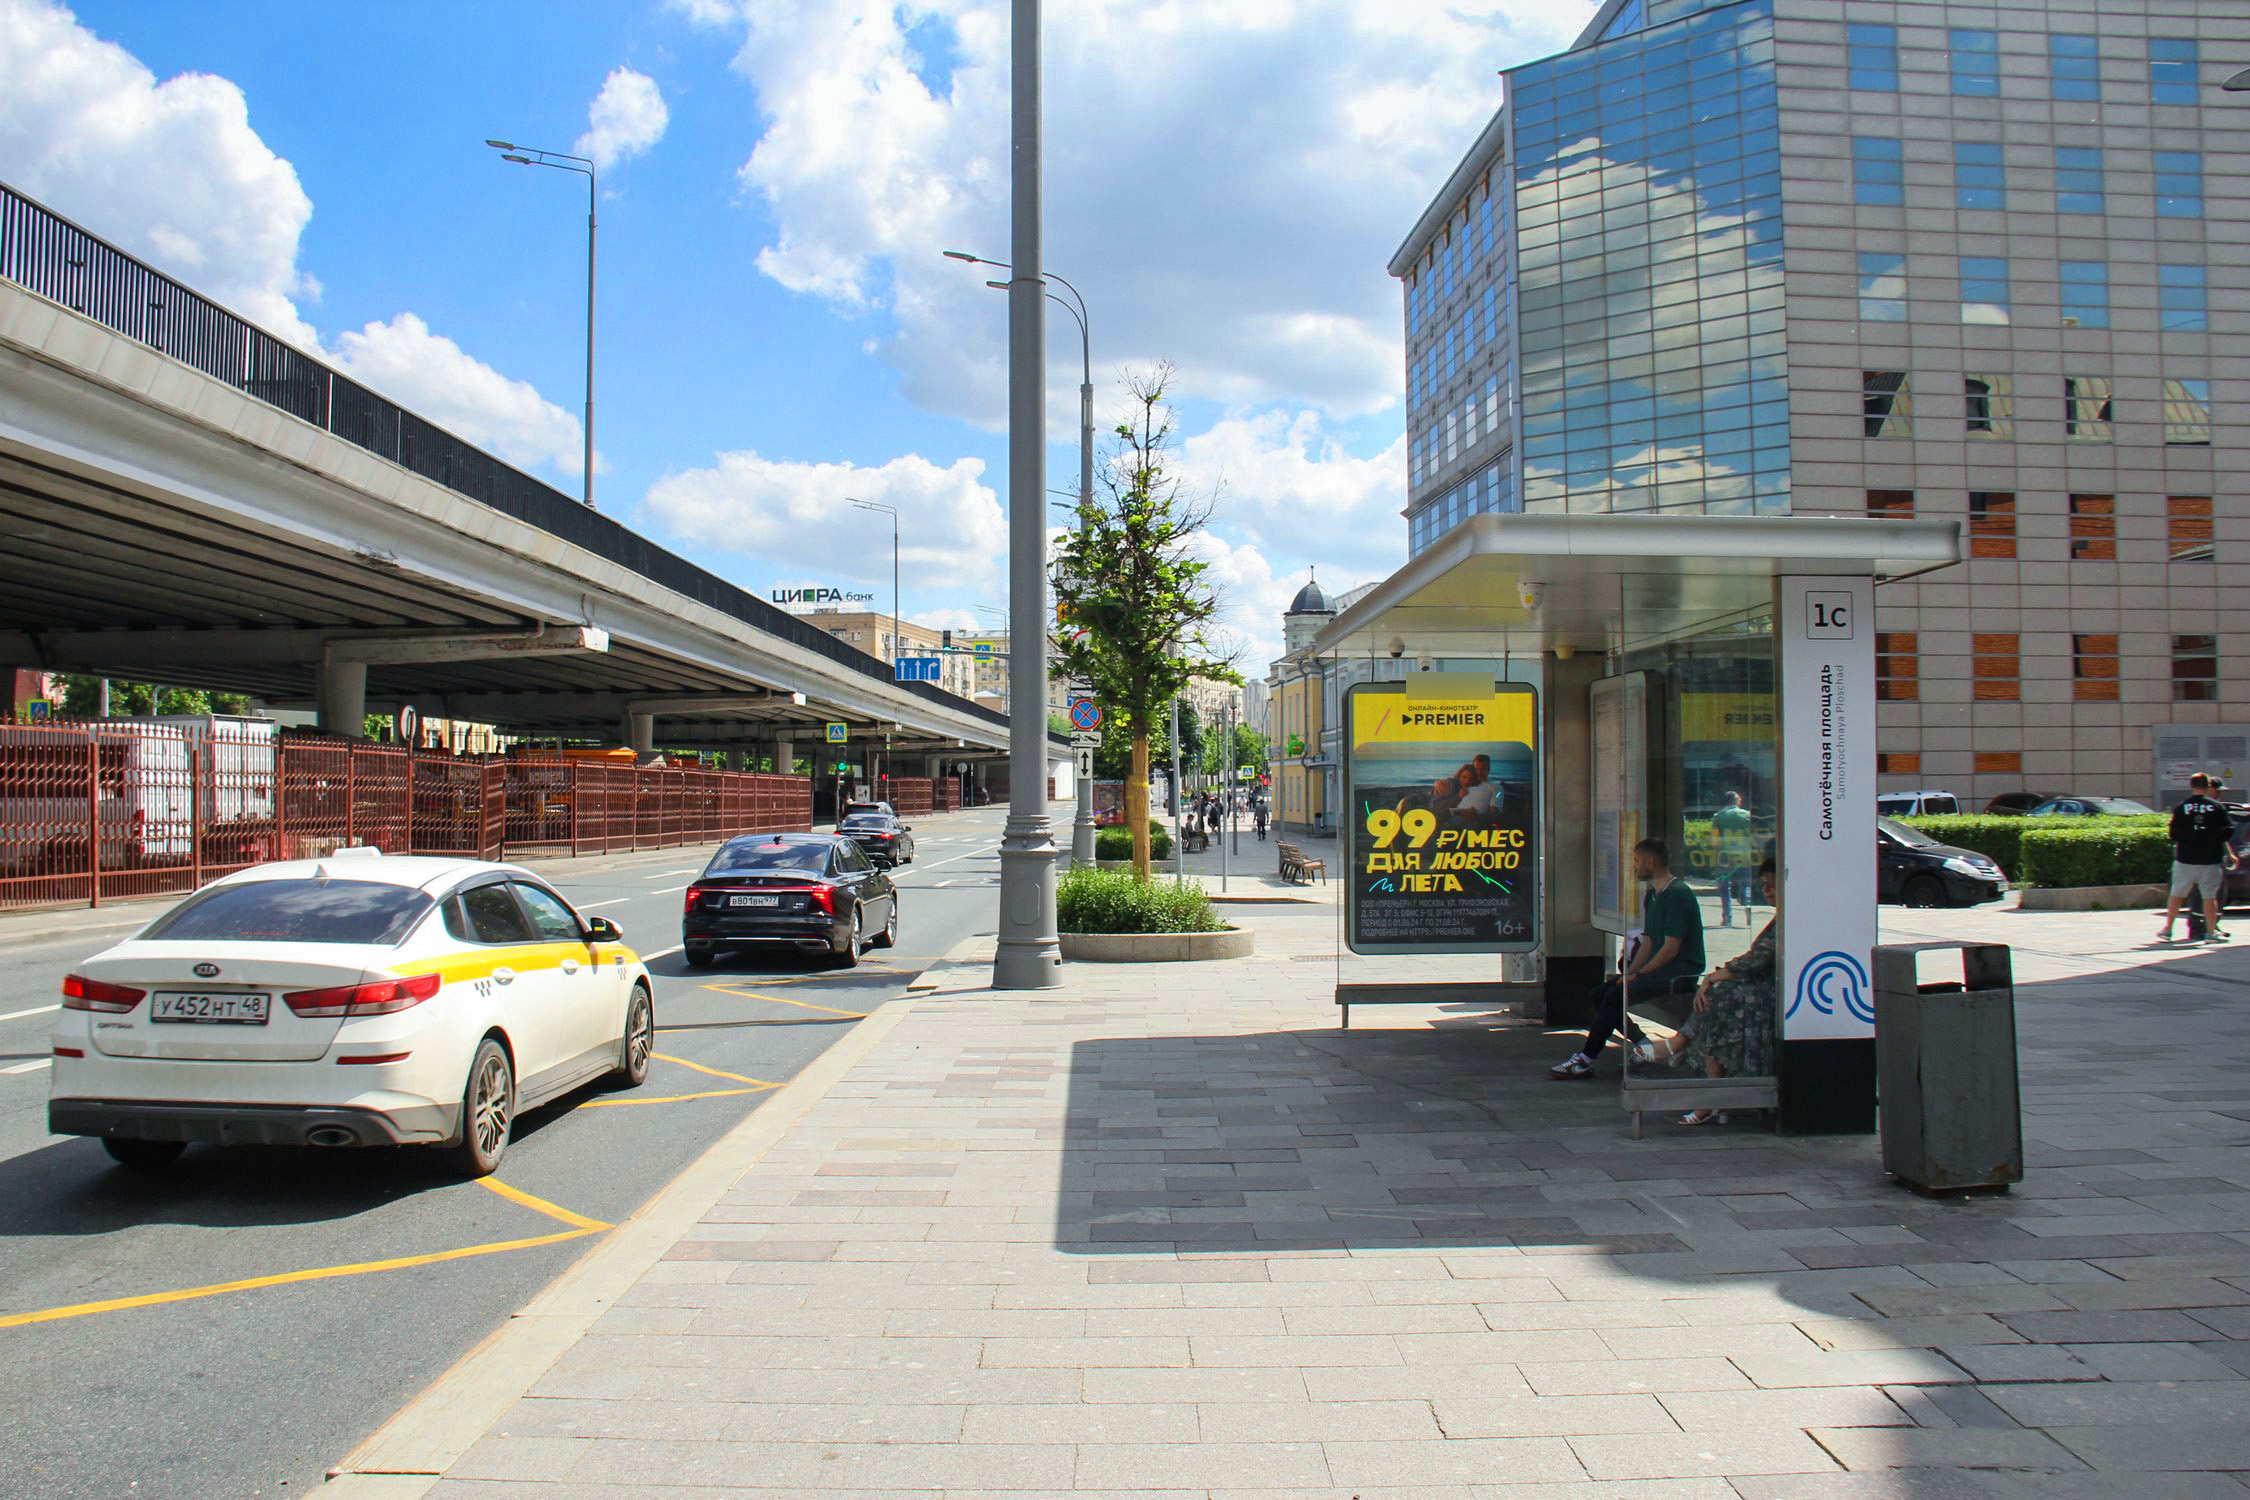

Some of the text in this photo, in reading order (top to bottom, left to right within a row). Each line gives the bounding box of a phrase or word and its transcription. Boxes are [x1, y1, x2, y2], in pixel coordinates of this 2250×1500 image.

[846, 591, 874, 601] банк
[1414, 714, 1485, 725] PREMIER
[1836, 665, 1847, 800] Samotyochnaya Ploschad
[1819, 664, 1834, 841] Самотёчная площадь
[1366, 809, 1437, 849] 99
[1366, 851, 1519, 873] ДЛЯ ЛЮБОГО
[1400, 874, 1464, 892] ЛЕТА
[1494, 920, 1525, 935] 16+
[195, 965, 218, 976] KIA
[242, 997, 260, 1012] 48
